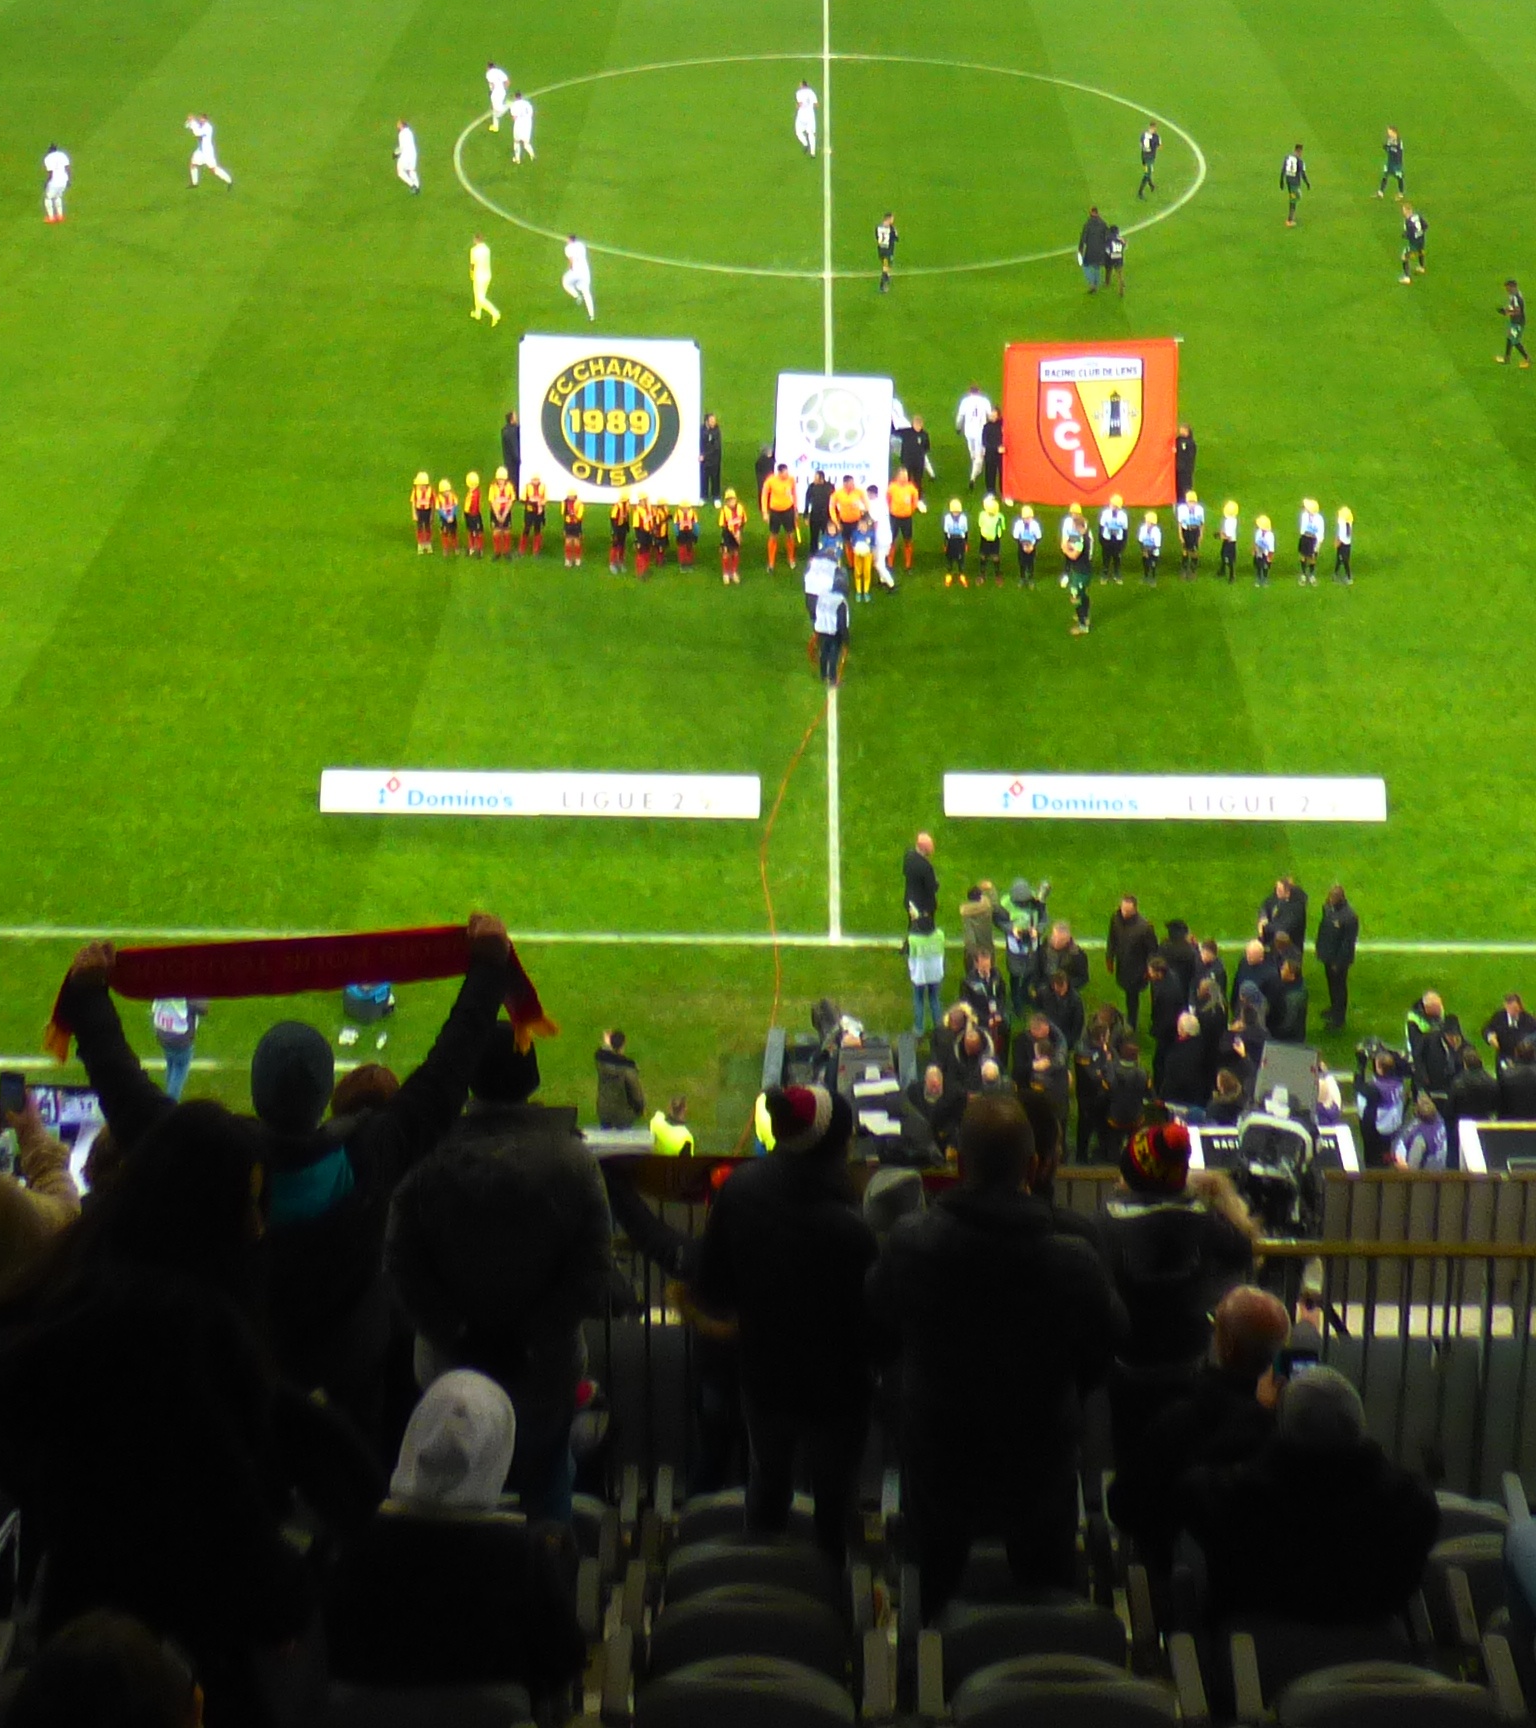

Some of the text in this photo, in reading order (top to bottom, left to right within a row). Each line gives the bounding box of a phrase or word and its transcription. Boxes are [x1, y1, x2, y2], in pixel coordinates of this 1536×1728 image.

[548, 358, 672, 407] FC CHAMBLY
[1045, 366, 1137, 378] RACING CLUB DE LENS
[569, 408, 650, 435] 1989
[1046, 388, 1097, 478] RCL
[572, 461, 649, 487] OISE
[407, 789, 684, 810] Domino's LIGUE 2
[1031, 793, 1311, 814] Domino's LIGUE 2
